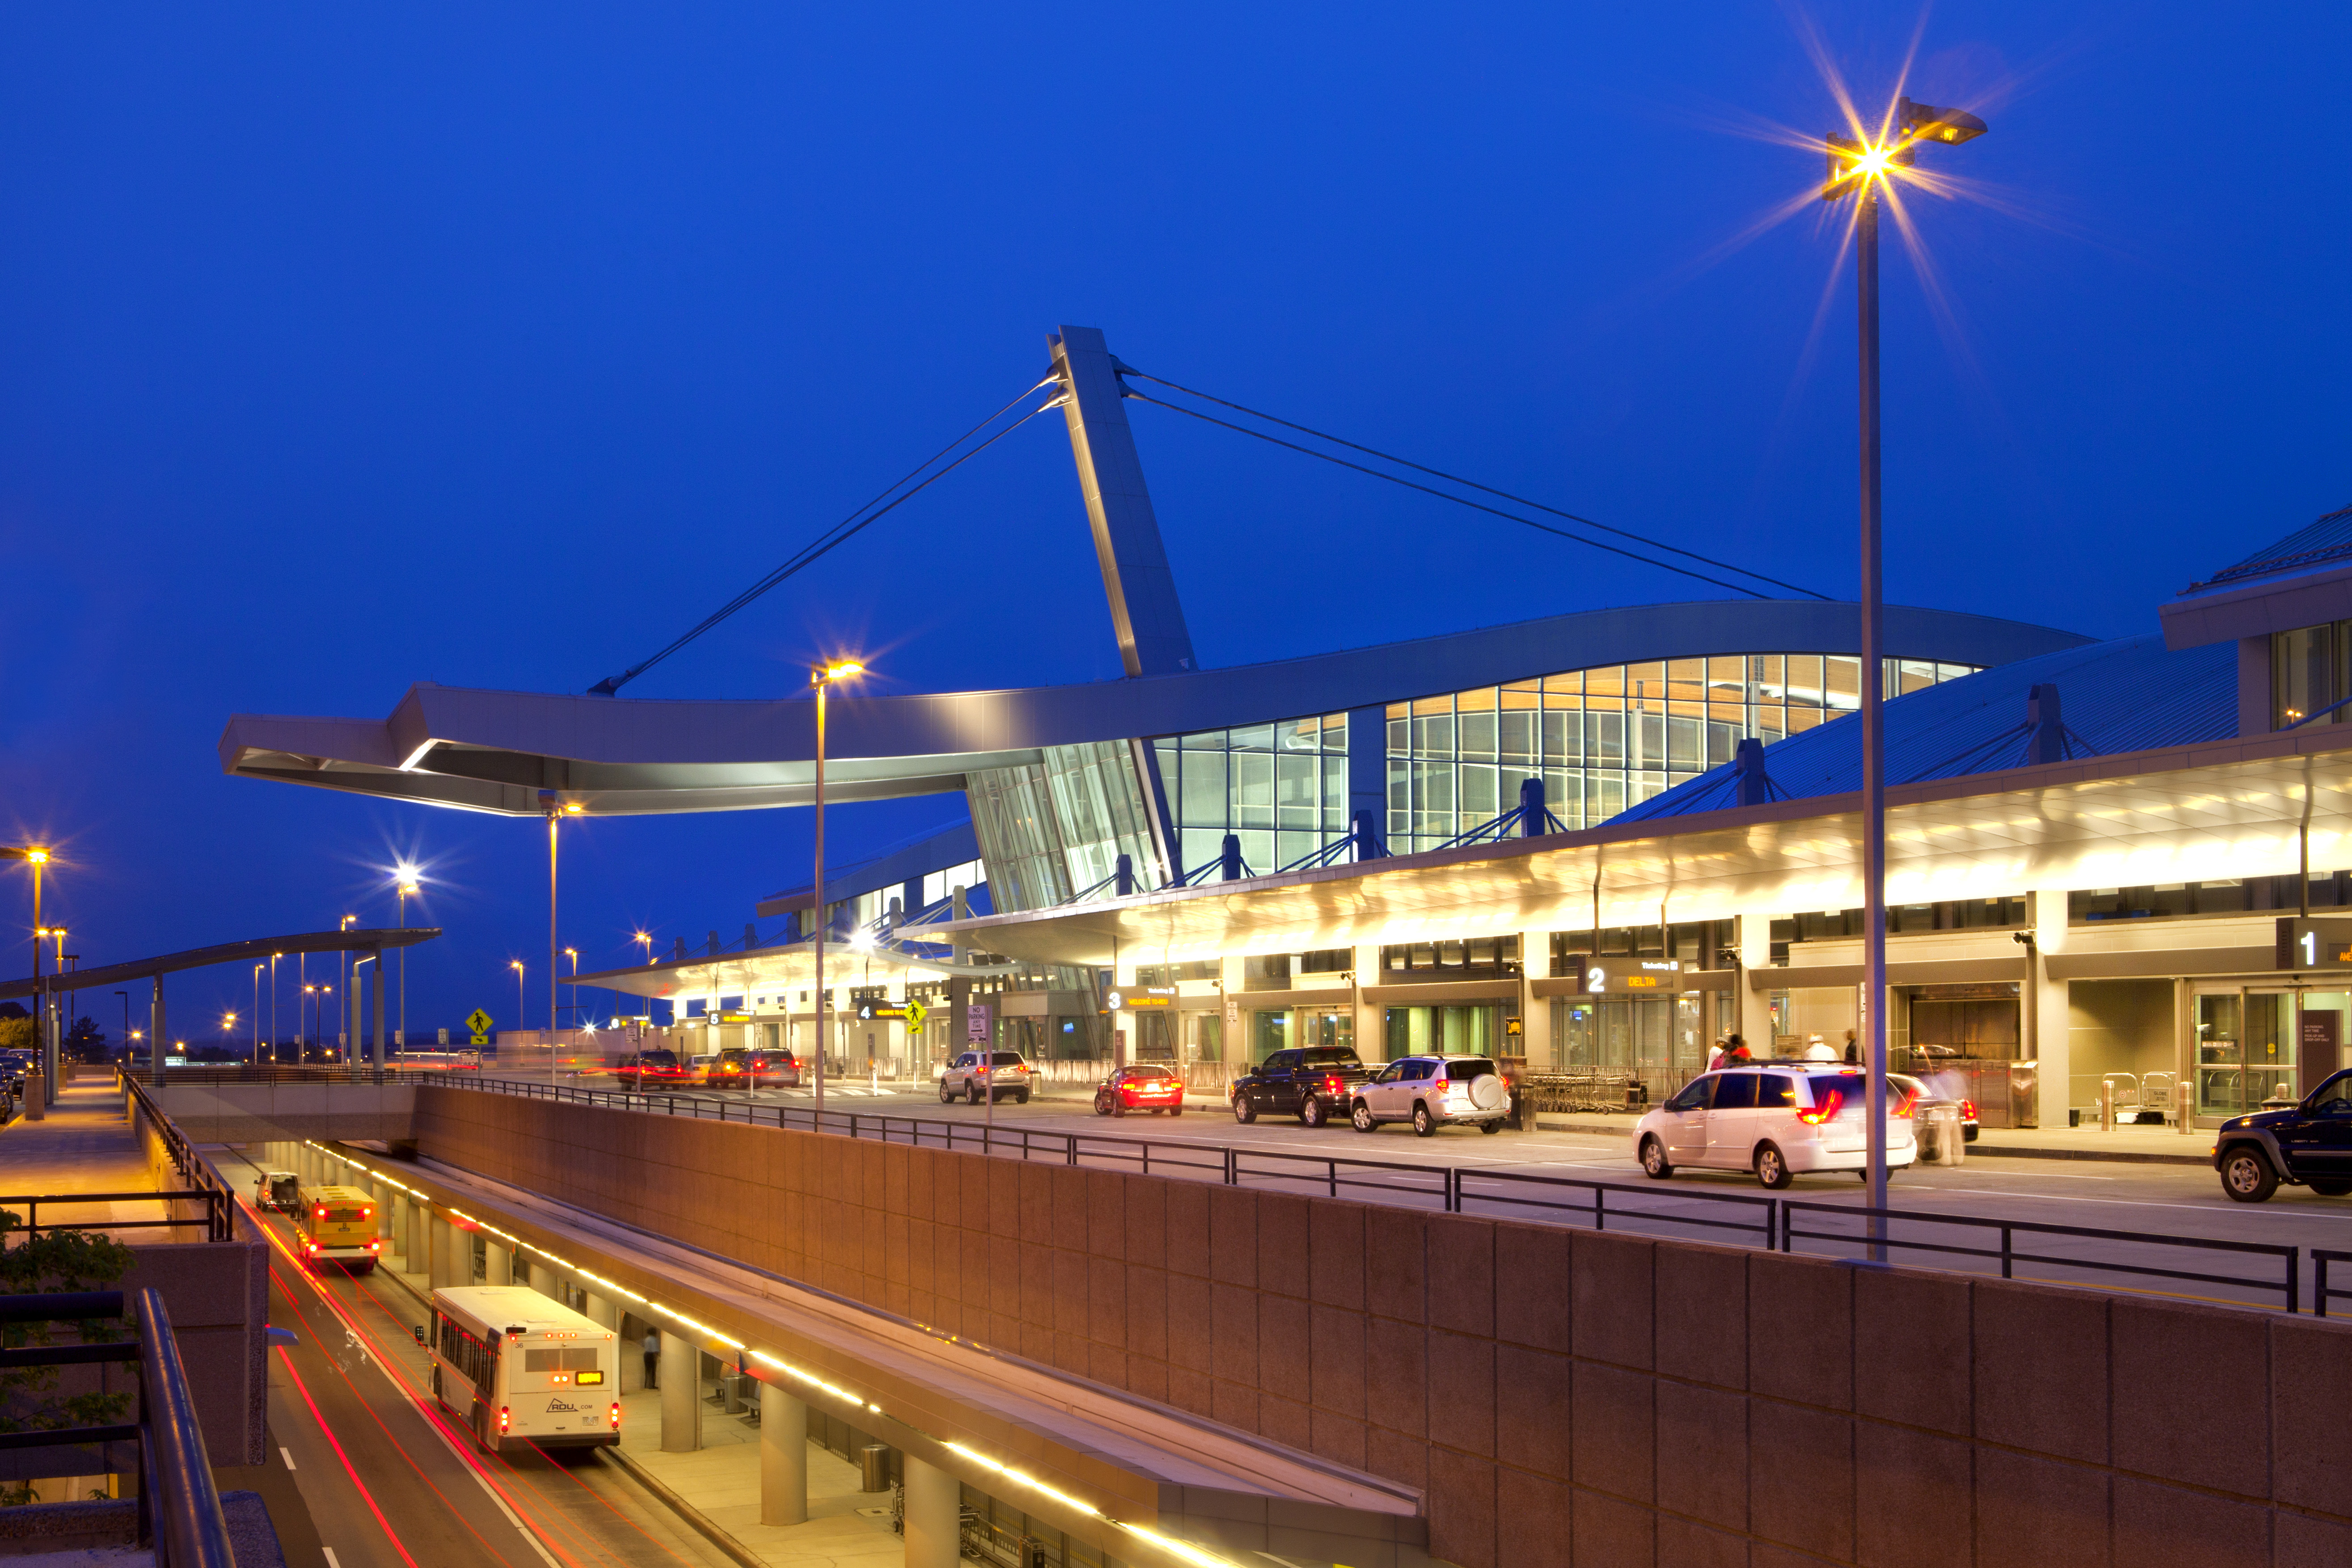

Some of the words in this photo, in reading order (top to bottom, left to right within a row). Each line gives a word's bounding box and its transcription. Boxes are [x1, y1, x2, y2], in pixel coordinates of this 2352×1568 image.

[2301, 932, 2314, 964] 1
[1589, 968, 1604, 991] 2
[1628, 977, 1656, 986] DELTA
[1109, 992, 1120, 1009] 3
[711, 1014, 718, 1024] 5
[861, 1006, 870, 1019] 4
[612, 1019, 619, 1028] 6
